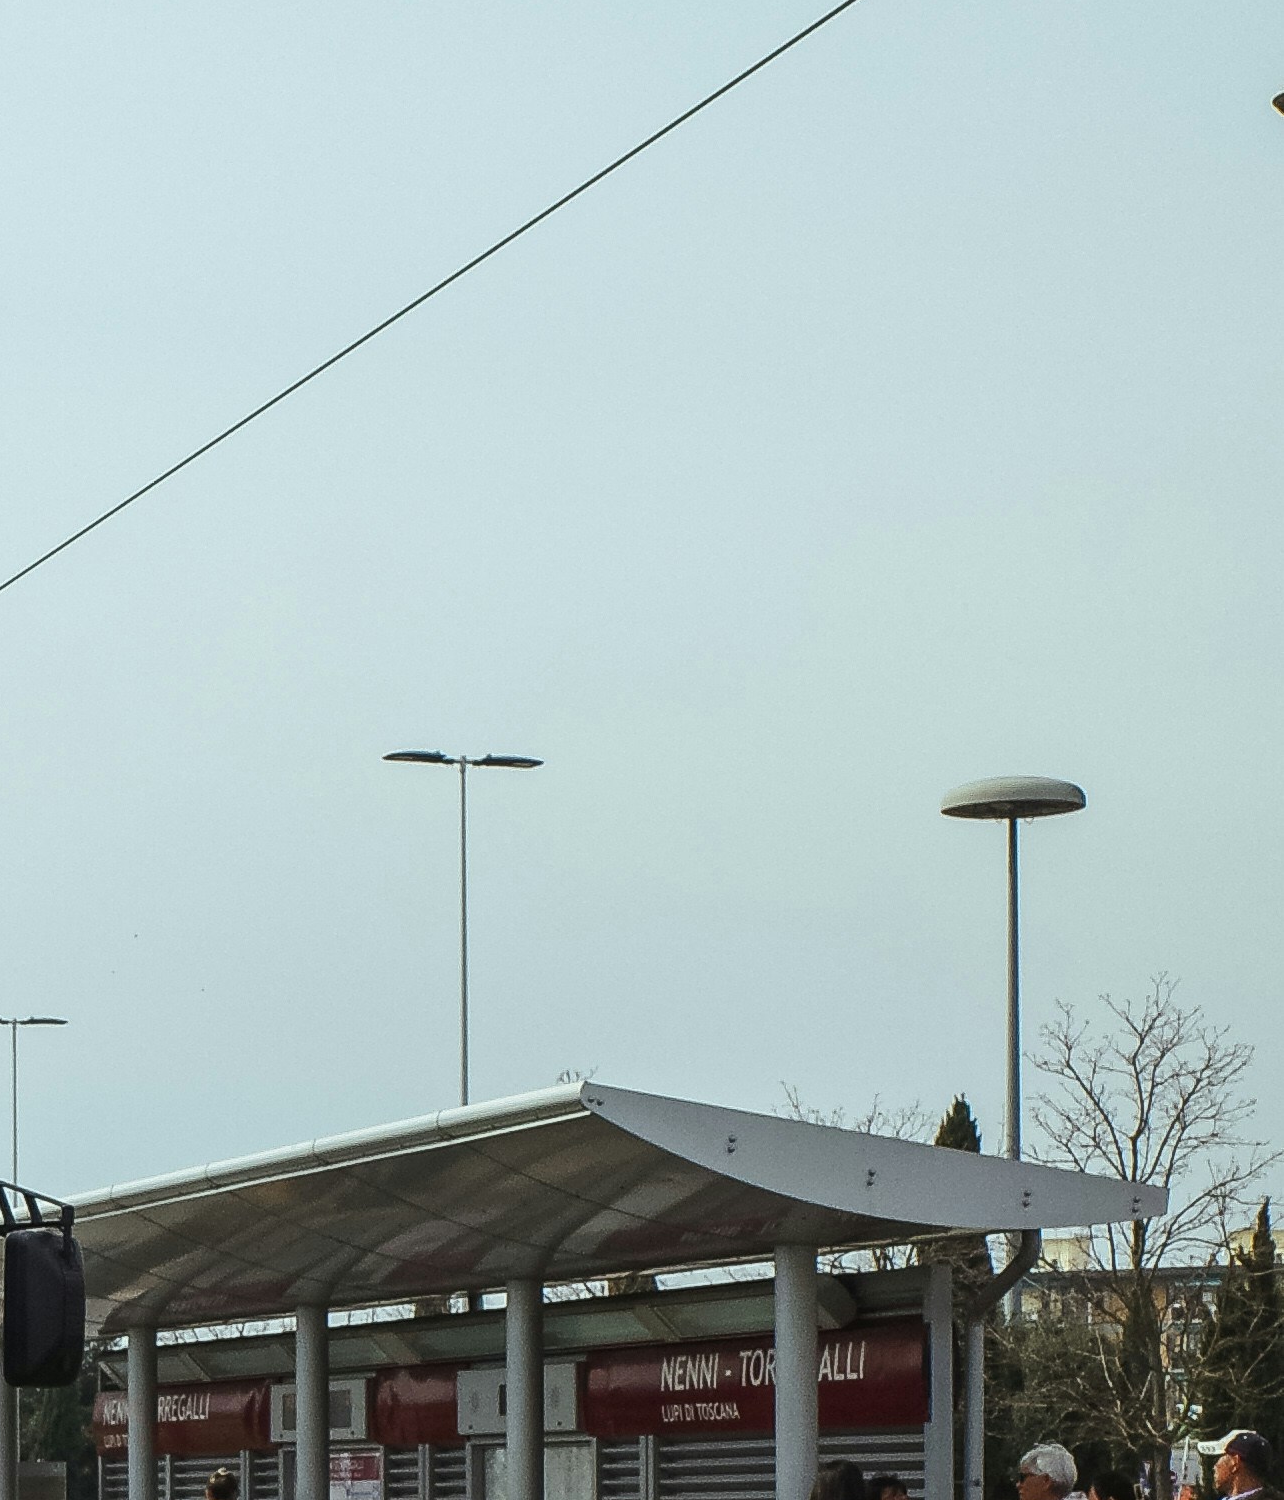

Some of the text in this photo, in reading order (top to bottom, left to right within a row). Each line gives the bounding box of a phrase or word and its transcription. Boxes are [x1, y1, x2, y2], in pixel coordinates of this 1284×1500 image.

[660, 1352, 720, 1392] NENNI
[739, 1340, 866, 1387] TORALLI
[661, 1402, 741, 1423] LUPI DI TOSCANA
